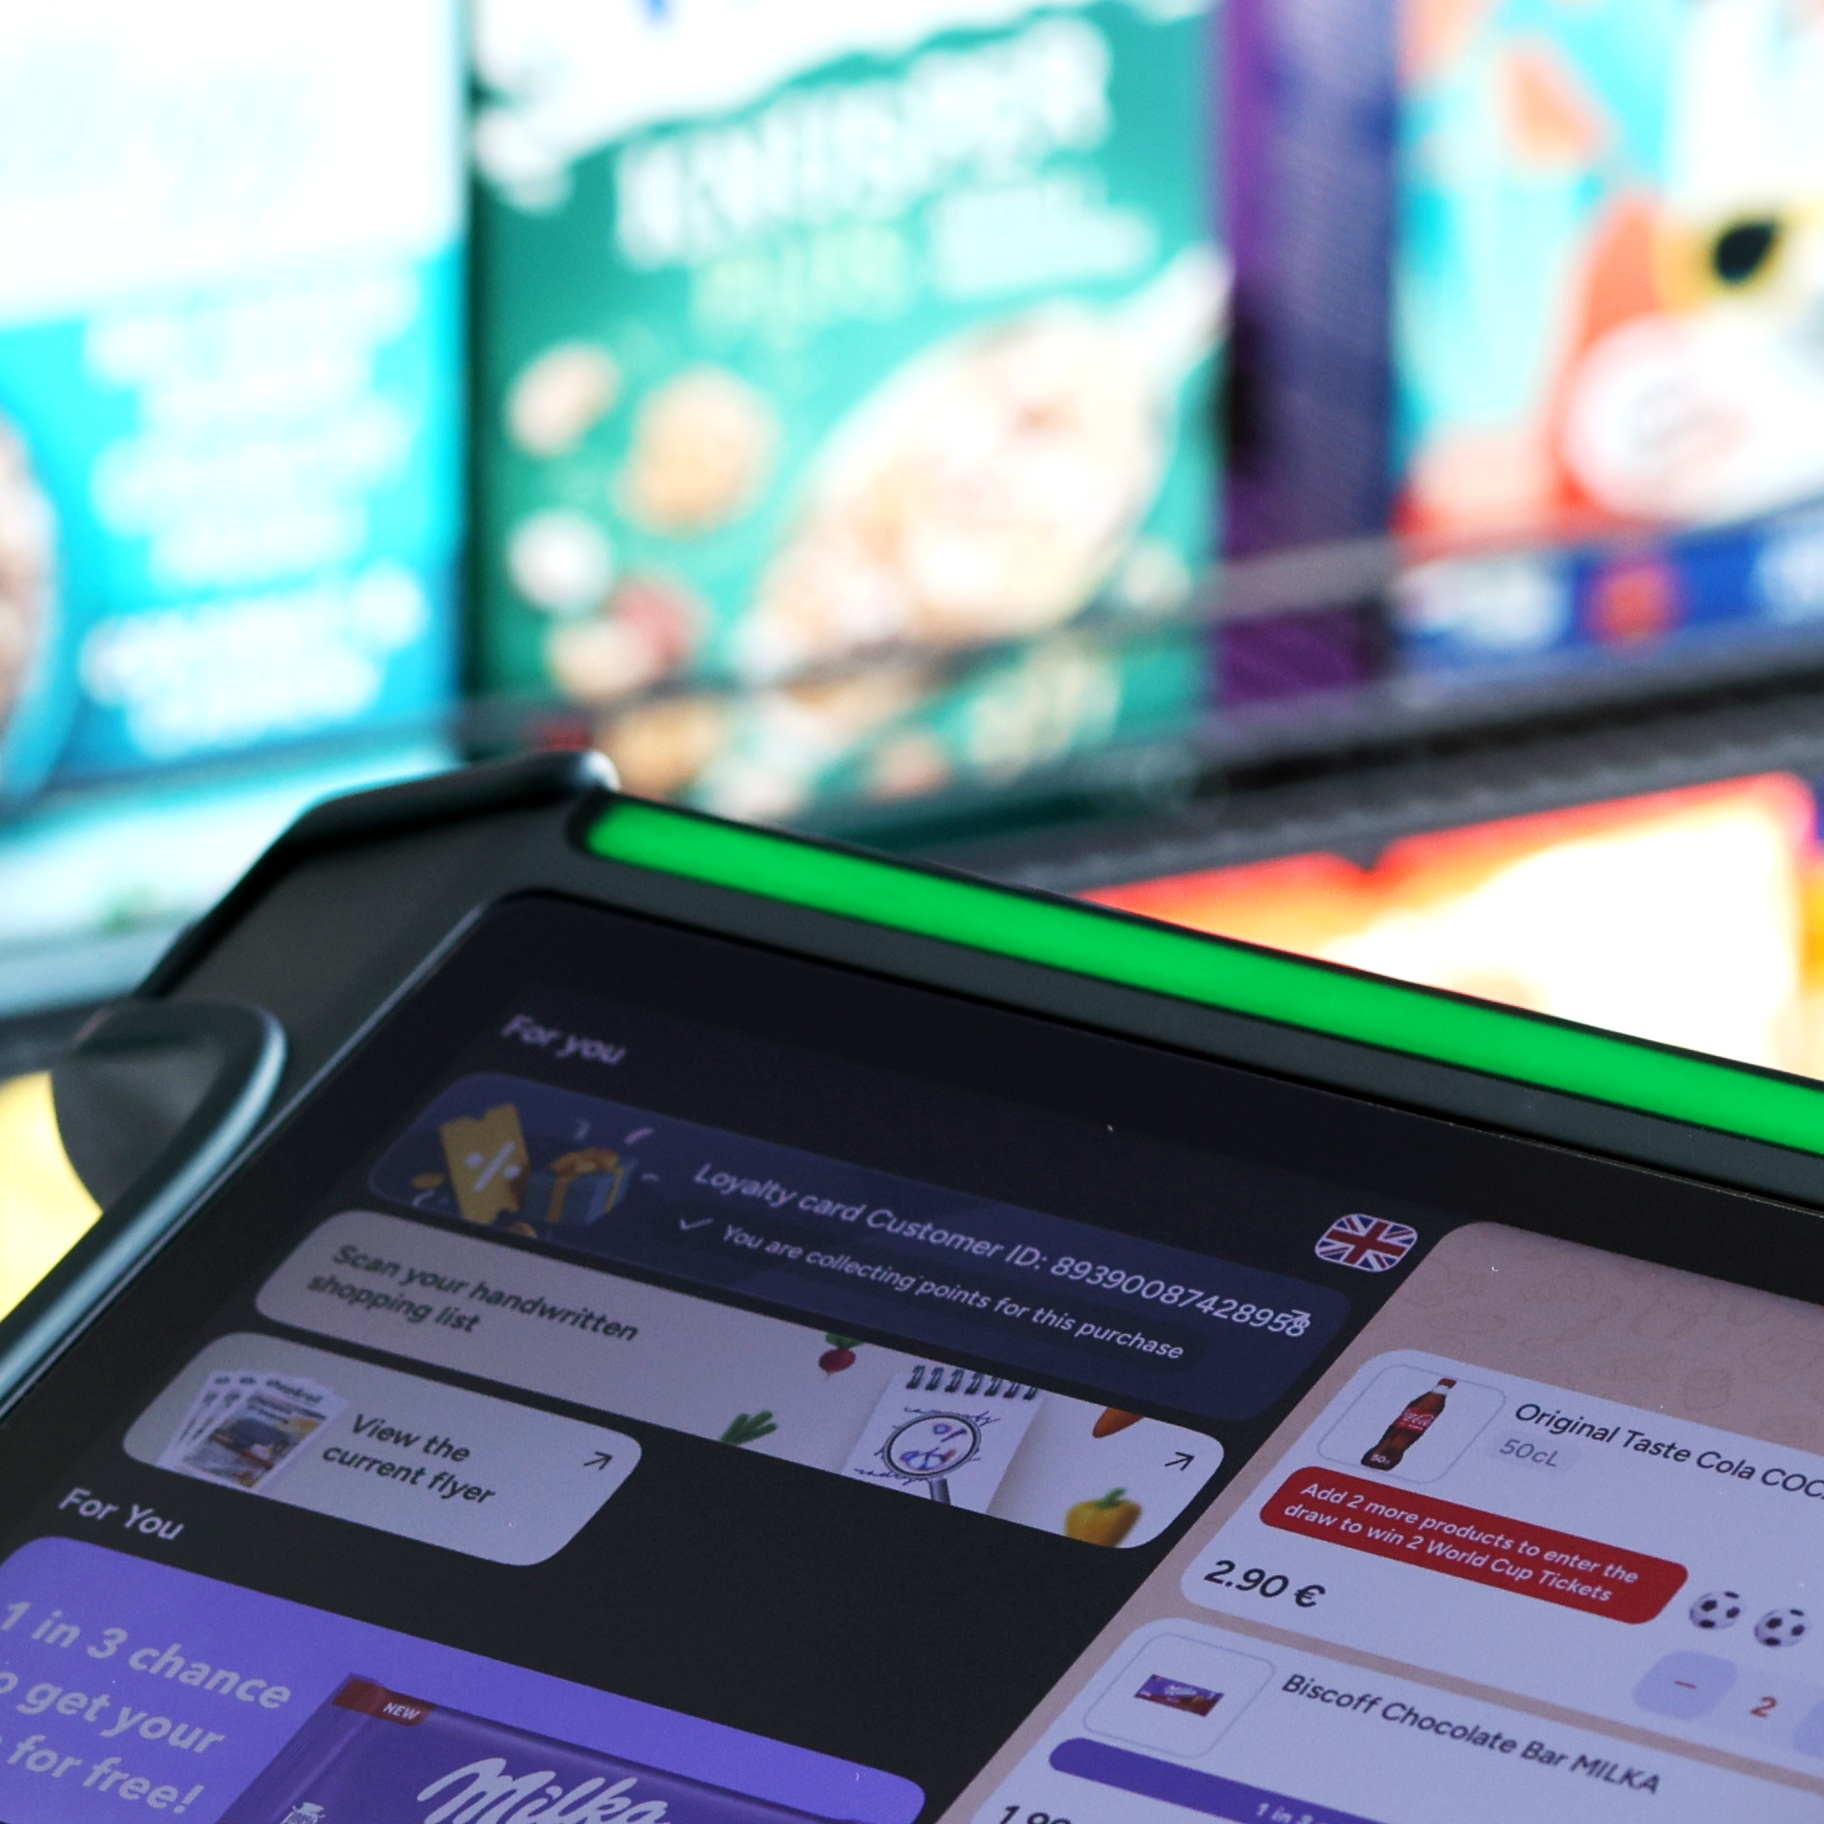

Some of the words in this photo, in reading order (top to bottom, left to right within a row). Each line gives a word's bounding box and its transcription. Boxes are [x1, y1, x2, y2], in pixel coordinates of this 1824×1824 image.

[501, 1013, 560, 1046] For
[555, 1035, 626, 1066] you
[693, 1163, 798, 1207] Loyalty
[798, 1191, 866, 1222] card
[866, 1208, 1005, 1258] Customer
[1005, 1244, 1048, 1271] ID:
[1050, 1256, 1311, 1338] 89390087428958
[307, 1274, 433, 1323] shopping
[434, 1304, 481, 1333] list
[332, 1245, 401, 1278] Scan
[399, 1265, 468, 1294] your
[468, 1280, 639, 1342] handwritten
[722, 1225, 764, 1249] You
[764, 1241, 804, 1260] are
[805, 1249, 917, 1292] collecting
[915, 1280, 991, 1310] points
[993, 1296, 1031, 1318] for
[1031, 1306, 1076, 1331] this
[1075, 1323, 1185, 1359] purchase
[352, 1413, 421, 1448] View
[422, 1434, 471, 1463] the
[1499, 1438, 1560, 1469] 50cL
[1514, 1402, 1619, 1445] Original
[1623, 1429, 1692, 1464] Taste
[1695, 1450, 1756, 1481] Cola
[322, 1446, 426, 1486] current
[427, 1472, 496, 1504] flyer
[57, 1487, 118, 1521] For
[123, 1504, 185, 1541] You
[1300, 1481, 1346, 1504] Add
[1345, 1494, 1366, 1509] 2
[1364, 1501, 1420, 1524] more
[1419, 1513, 1516, 1551] products
[1516, 1538, 1543, 1558] to
[1543, 1547, 1602, 1574] enter
[1602, 1561, 1640, 1585] the
[1203, 1558, 1290, 1600] 2.90
[1294, 1583, 1327, 1609] €
[1283, 1502, 1338, 1527] draw
[1338, 1516, 1364, 1534] to
[1366, 1524, 1406, 1547] win
[1405, 1535, 1424, 1551] 2
[1426, 1540, 1489, 1569] World
[1489, 1556, 1534, 1582] Cup
[1537, 1569, 1613, 1603] Tickets
[0, 1601, 31, 1631] 1
[31, 1610, 81, 1649] in
[86, 1627, 128, 1660] 3
[128, 1642, 292, 1709] chance
[16, 1682, 111, 1723] get
[99, 1705, 226, 1754] your
[382, 1701, 421, 1722] NEW
[1281, 1673, 1381, 1715] Biscoff
[1380, 1701, 1518, 1755] Chocolate
[1520, 1739, 1570, 1768] Bar
[1570, 1754, 1661, 1795] MILKA
[1750, 1695, 1778, 1719] 2
[6, 1733, 82, 1779] for
[82, 1756, 206, 1816] free!
[1256, 1802, 1271, 1818] 1
[1270, 1806, 1292, 1824] in
